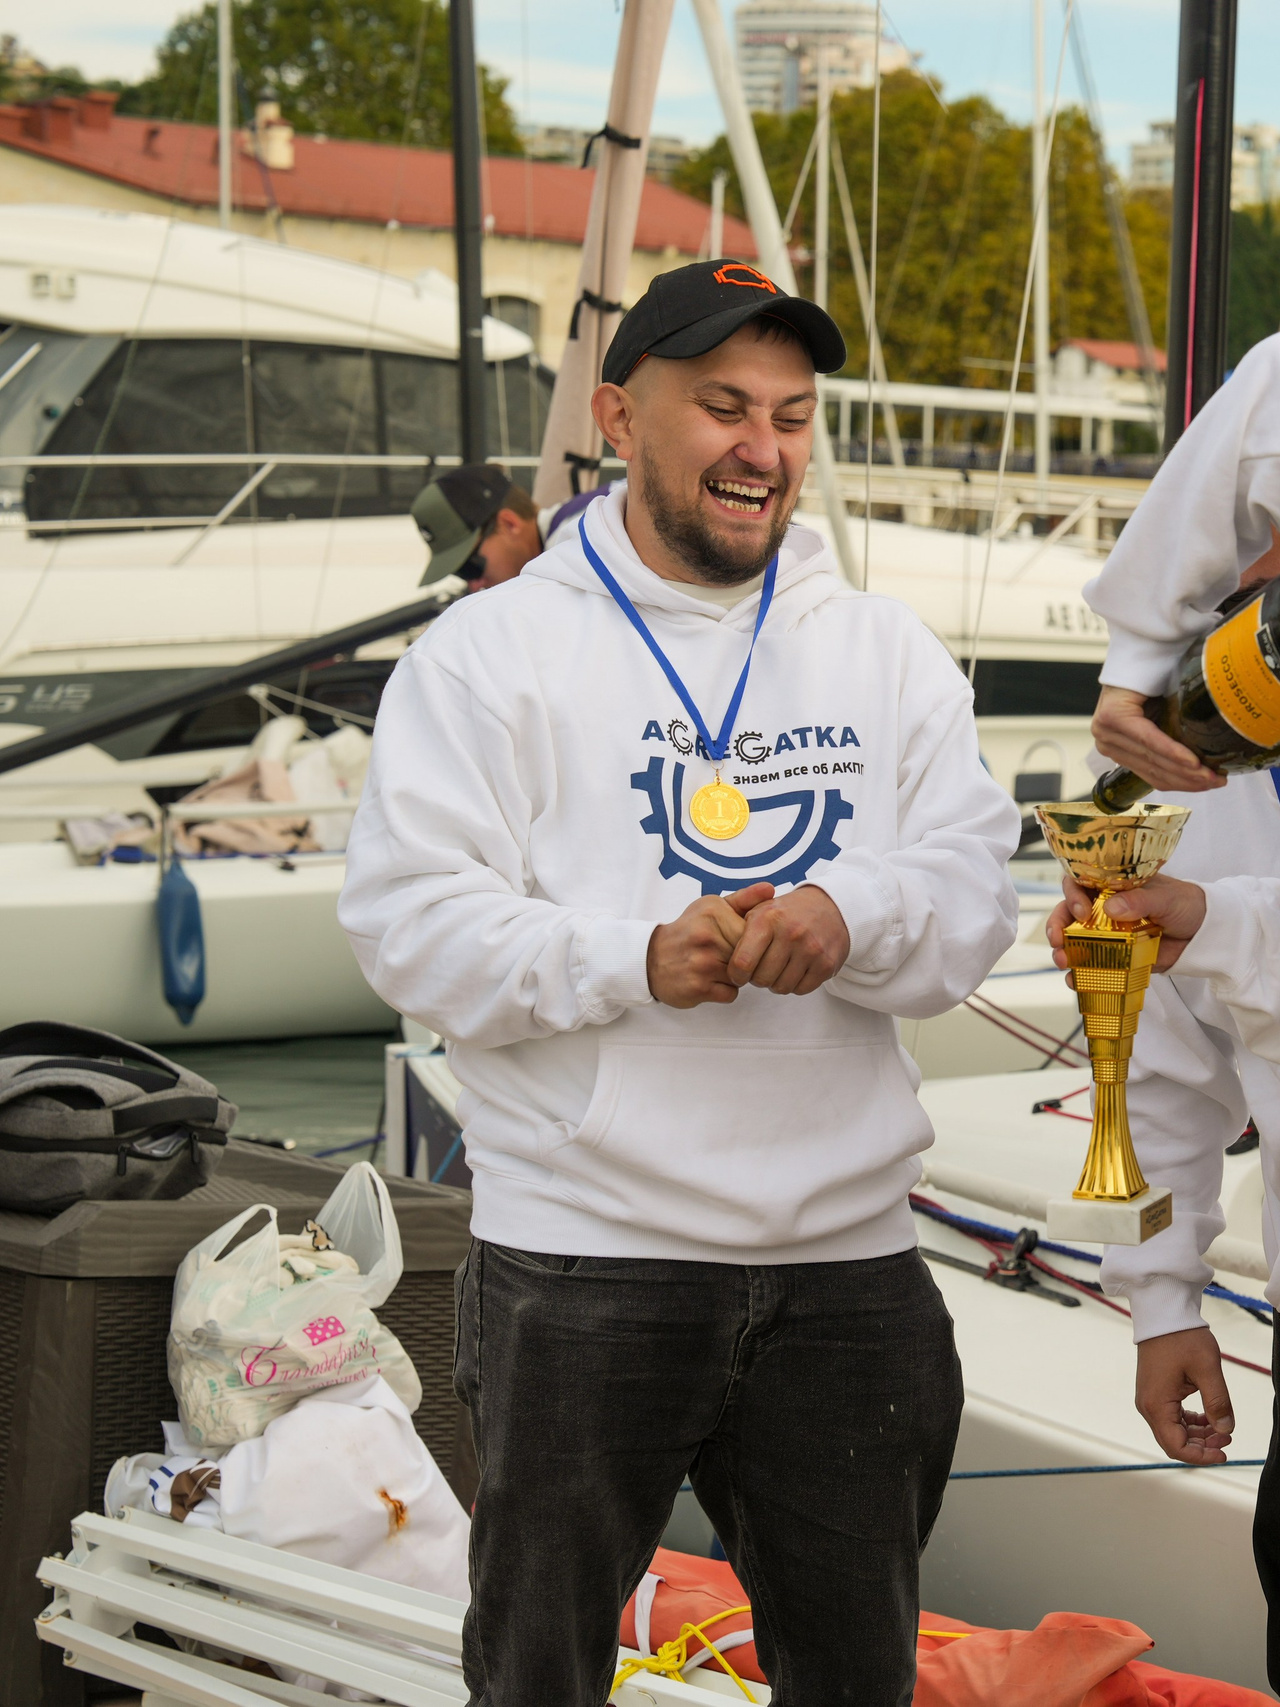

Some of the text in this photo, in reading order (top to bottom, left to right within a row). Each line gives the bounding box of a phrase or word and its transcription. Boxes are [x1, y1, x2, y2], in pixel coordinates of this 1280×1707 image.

[1220, 654, 1263, 720] PROSECCO
[733, 771, 780, 785] знаем
[784, 765, 808, 778] все
[812, 763, 829, 774] об
